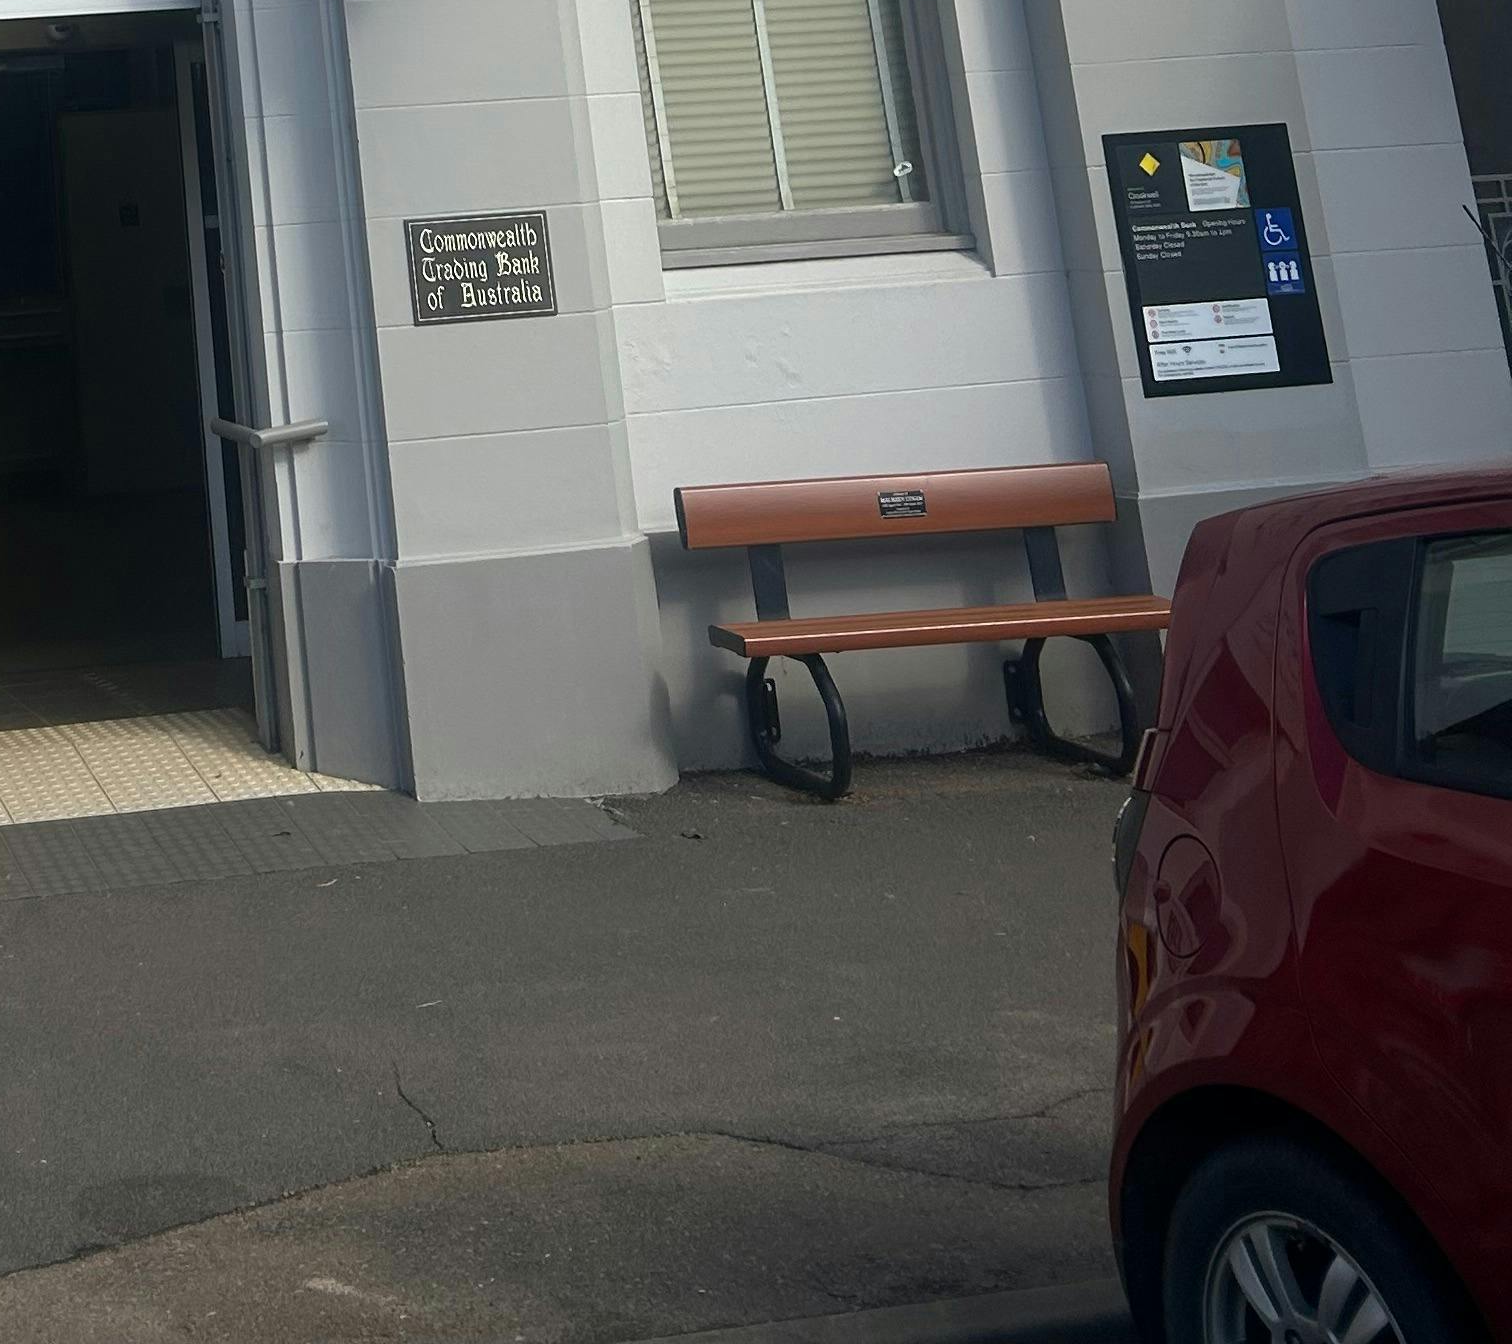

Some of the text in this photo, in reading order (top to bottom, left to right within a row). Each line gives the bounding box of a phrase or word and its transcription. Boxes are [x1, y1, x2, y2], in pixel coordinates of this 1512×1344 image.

[419, 222, 537, 253] Commonwealth
[421, 250, 540, 282] Trading Bank
[427, 278, 543, 311] of Australia
